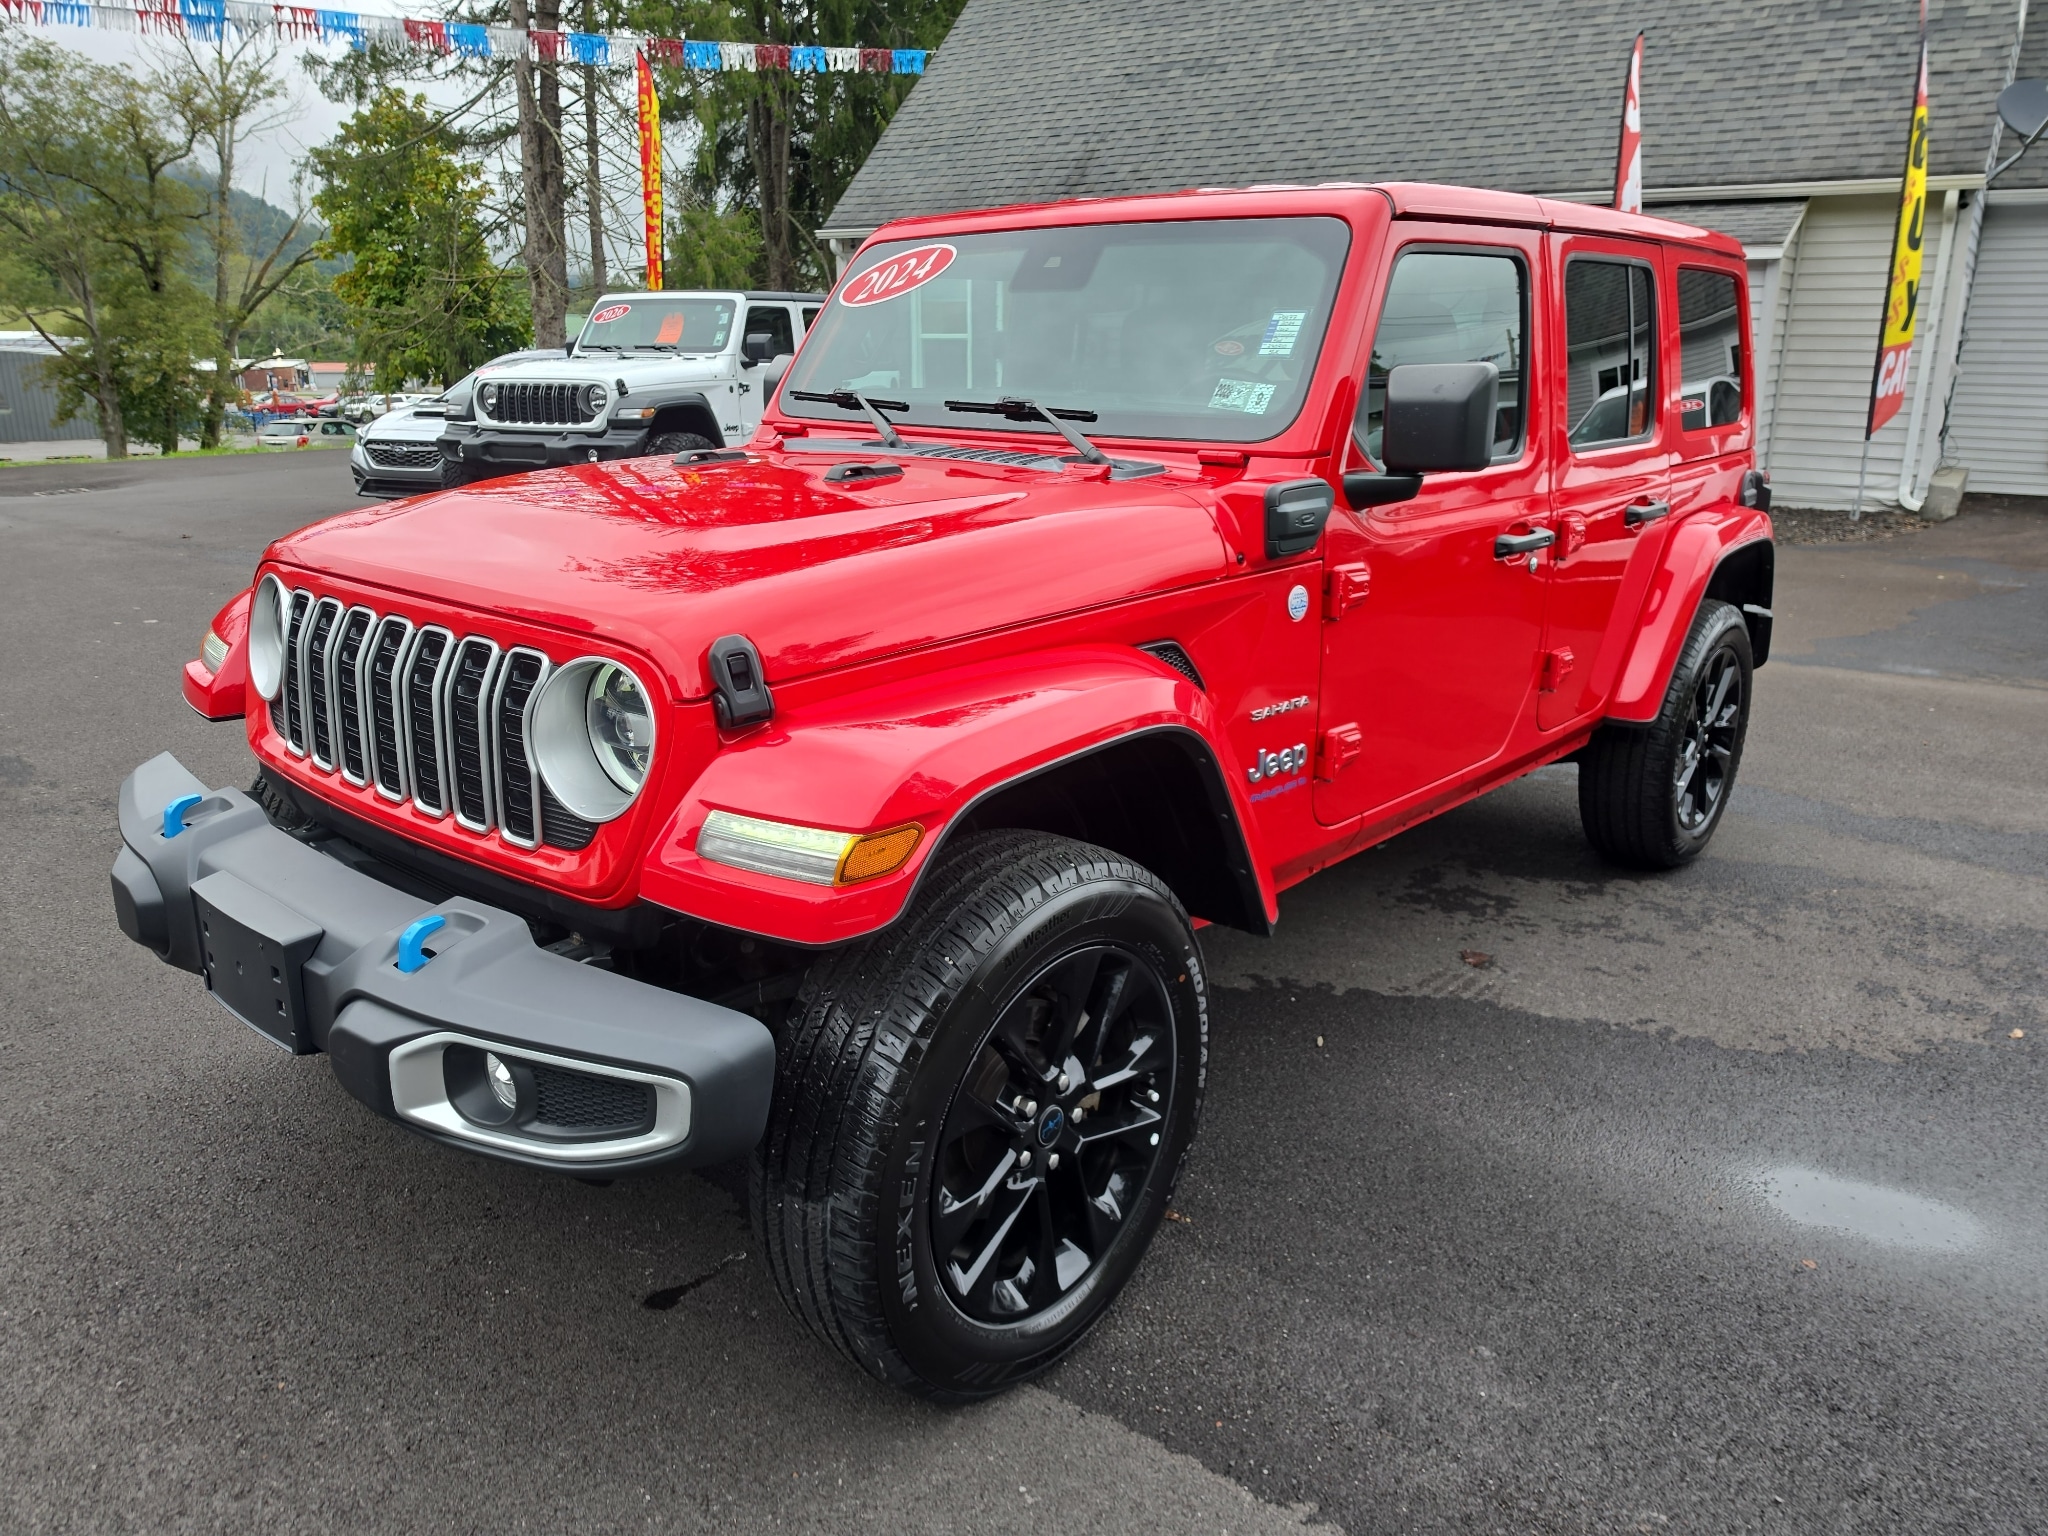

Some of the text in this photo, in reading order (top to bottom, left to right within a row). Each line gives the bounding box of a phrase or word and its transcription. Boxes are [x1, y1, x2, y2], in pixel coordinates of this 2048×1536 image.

[851, 247, 943, 303] 2024
[600, 306, 624, 321] 2026
[1250, 695, 1310, 722] SAHARA
[1248, 742, 1308, 783] Jeep
[1186, 956, 1209, 1089] ROADIAN
[896, 1141, 926, 1306] NEXEN
